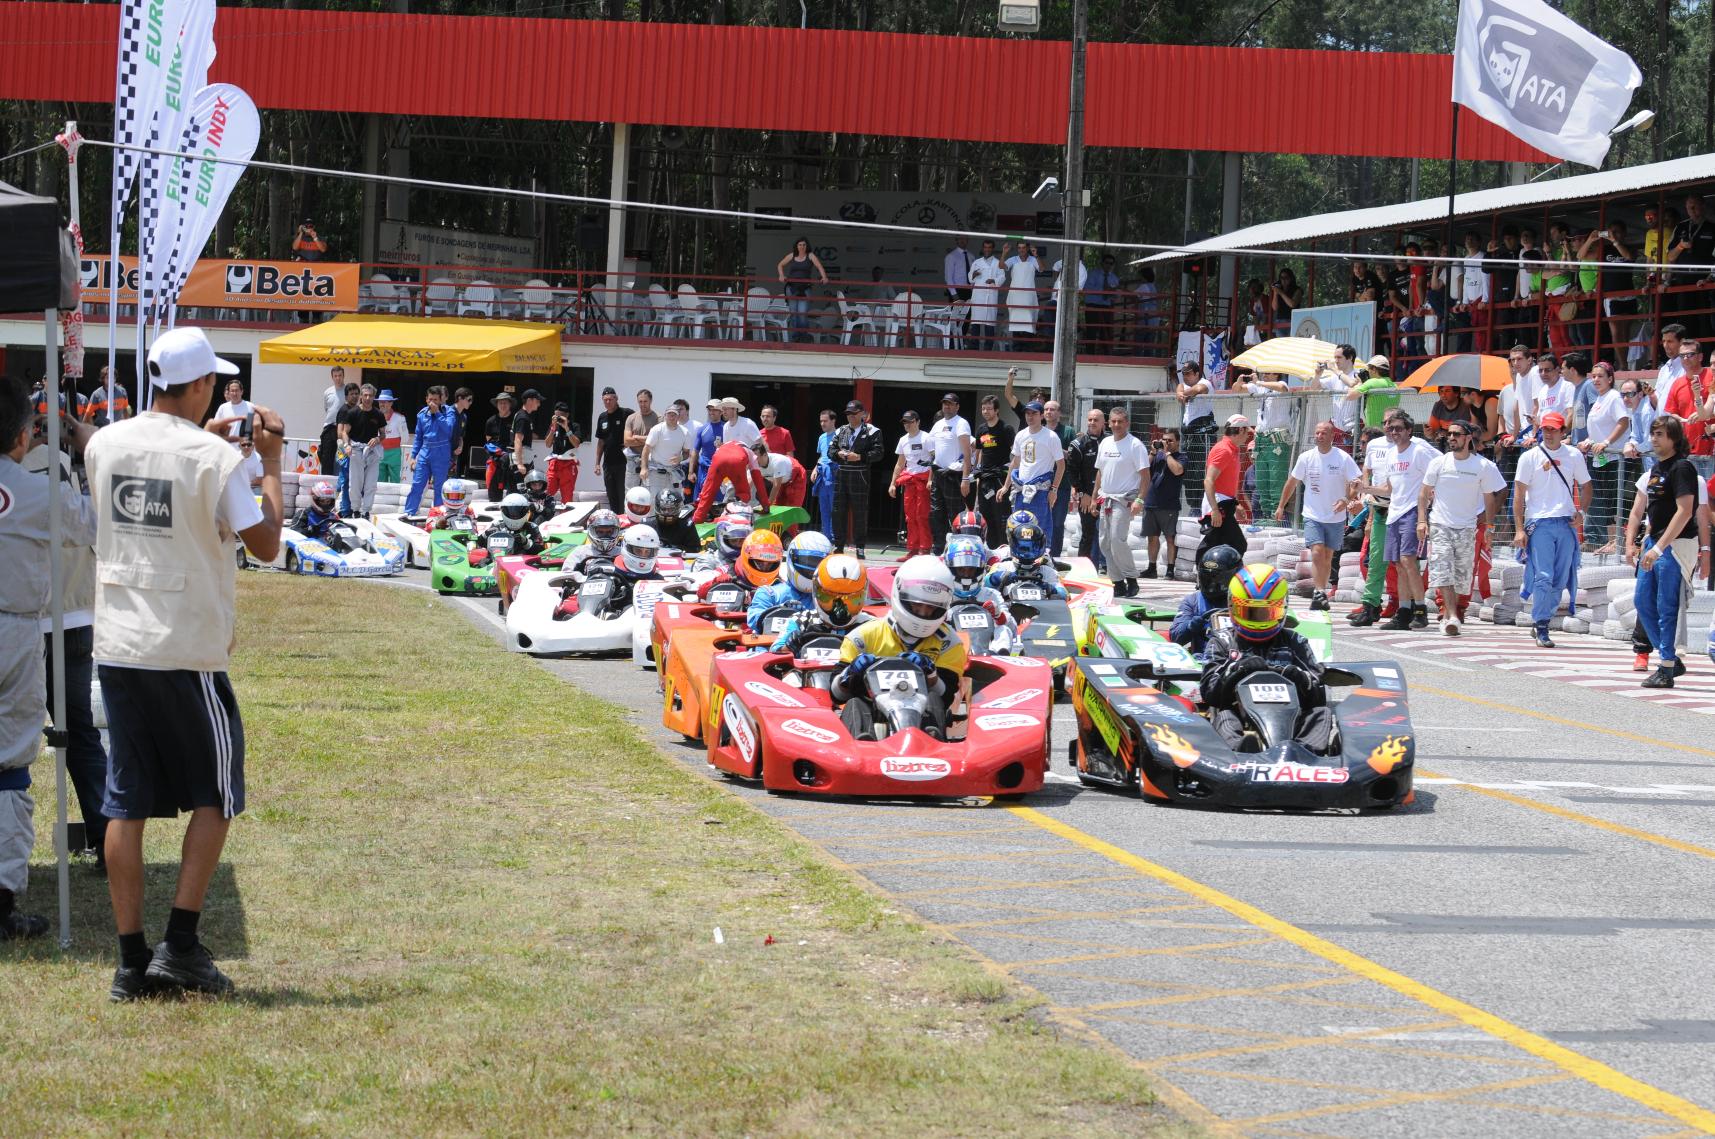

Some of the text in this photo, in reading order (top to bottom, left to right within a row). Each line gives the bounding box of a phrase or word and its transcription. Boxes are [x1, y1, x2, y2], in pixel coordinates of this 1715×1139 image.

[1480, 15, 1566, 113] GATA
[195, 96, 229, 208] EURO INDY
[257, 266, 335, 297] Beta
[299, 356, 465, 370] www.pestronix.pt
[113, 479, 170, 521] GATA
[814, 649, 833, 657] 17
[882, 671, 909, 680] 74
[786, 720, 834, 742] liztrez
[884, 759, 948, 773] liztrez
[1252, 765, 1350, 783] RACES
